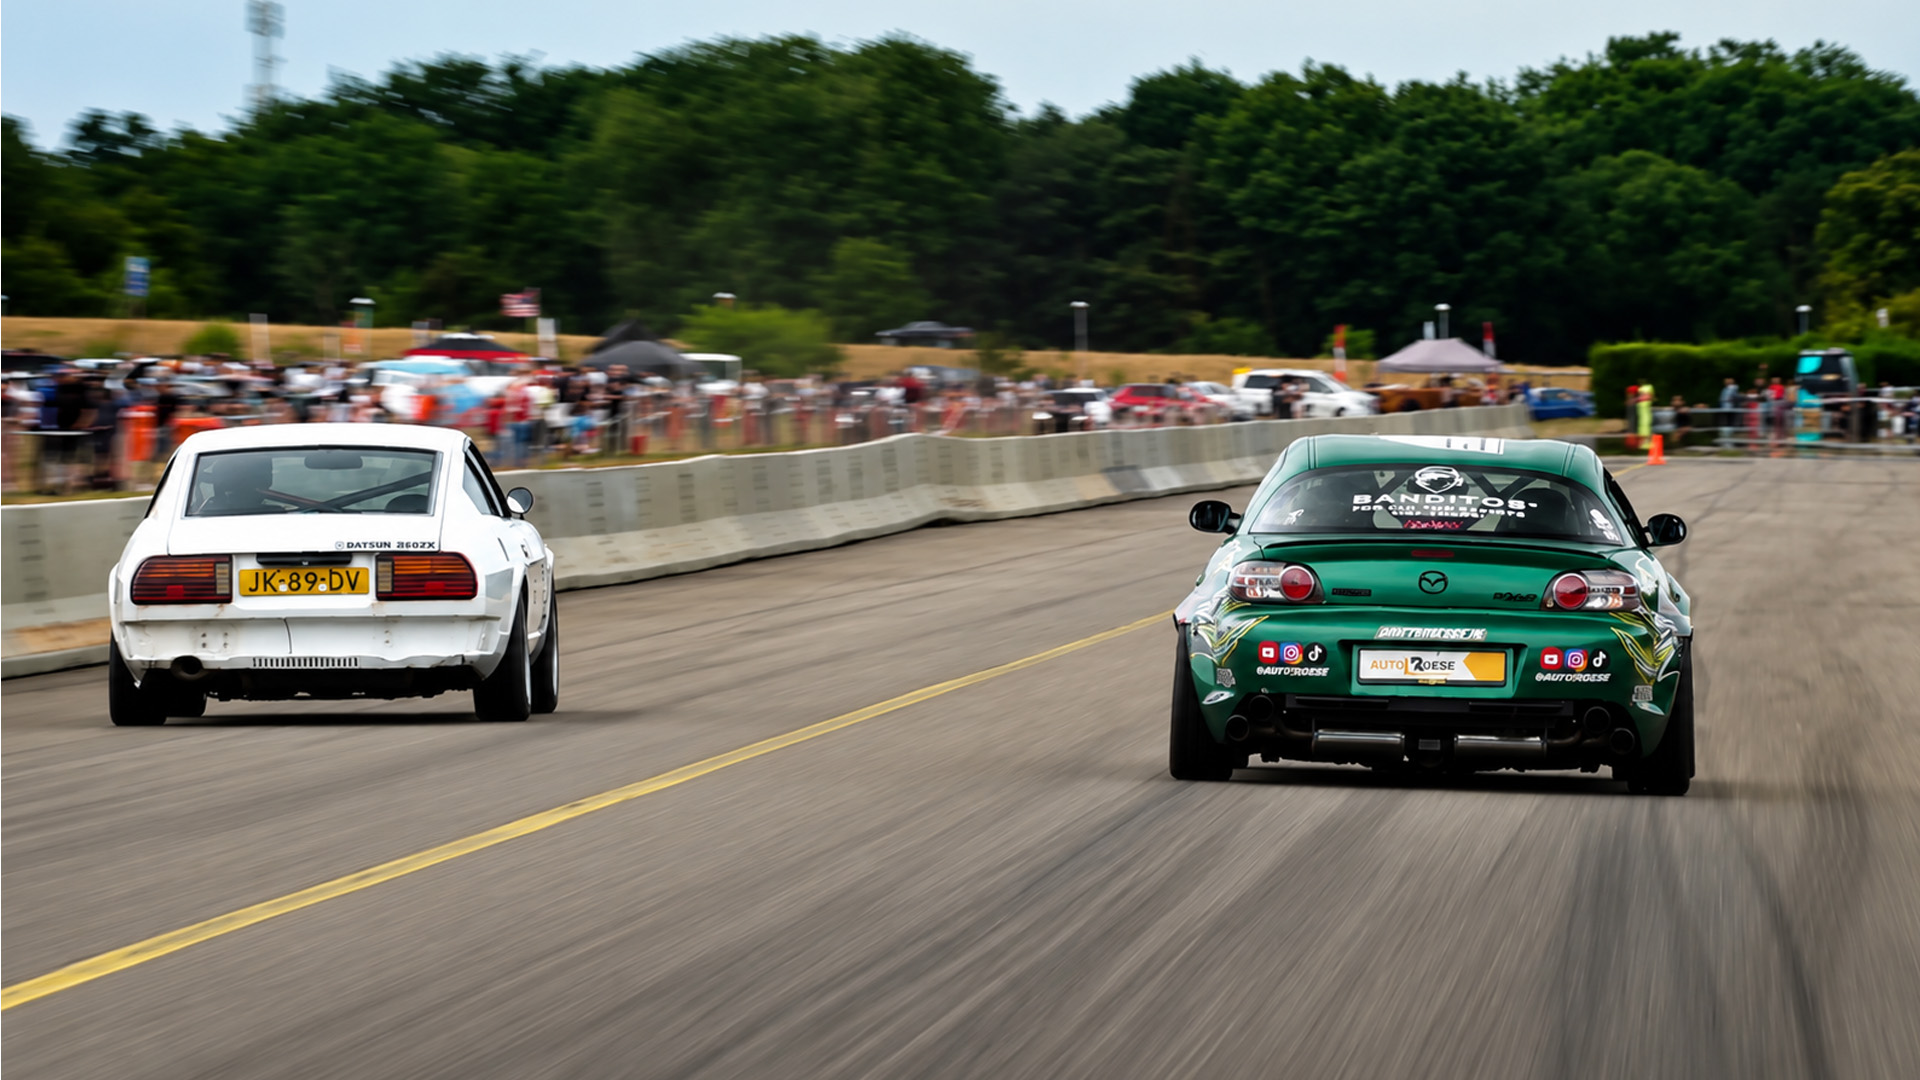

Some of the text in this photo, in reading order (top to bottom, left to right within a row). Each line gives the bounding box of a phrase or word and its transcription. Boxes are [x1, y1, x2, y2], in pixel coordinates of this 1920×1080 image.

[1352, 493, 1527, 510] BANDITOS
[346, 541, 391, 549] DATSUN
[248, 569, 360, 593] JK-89-DV
[1370, 659, 1404, 671] AUTO
